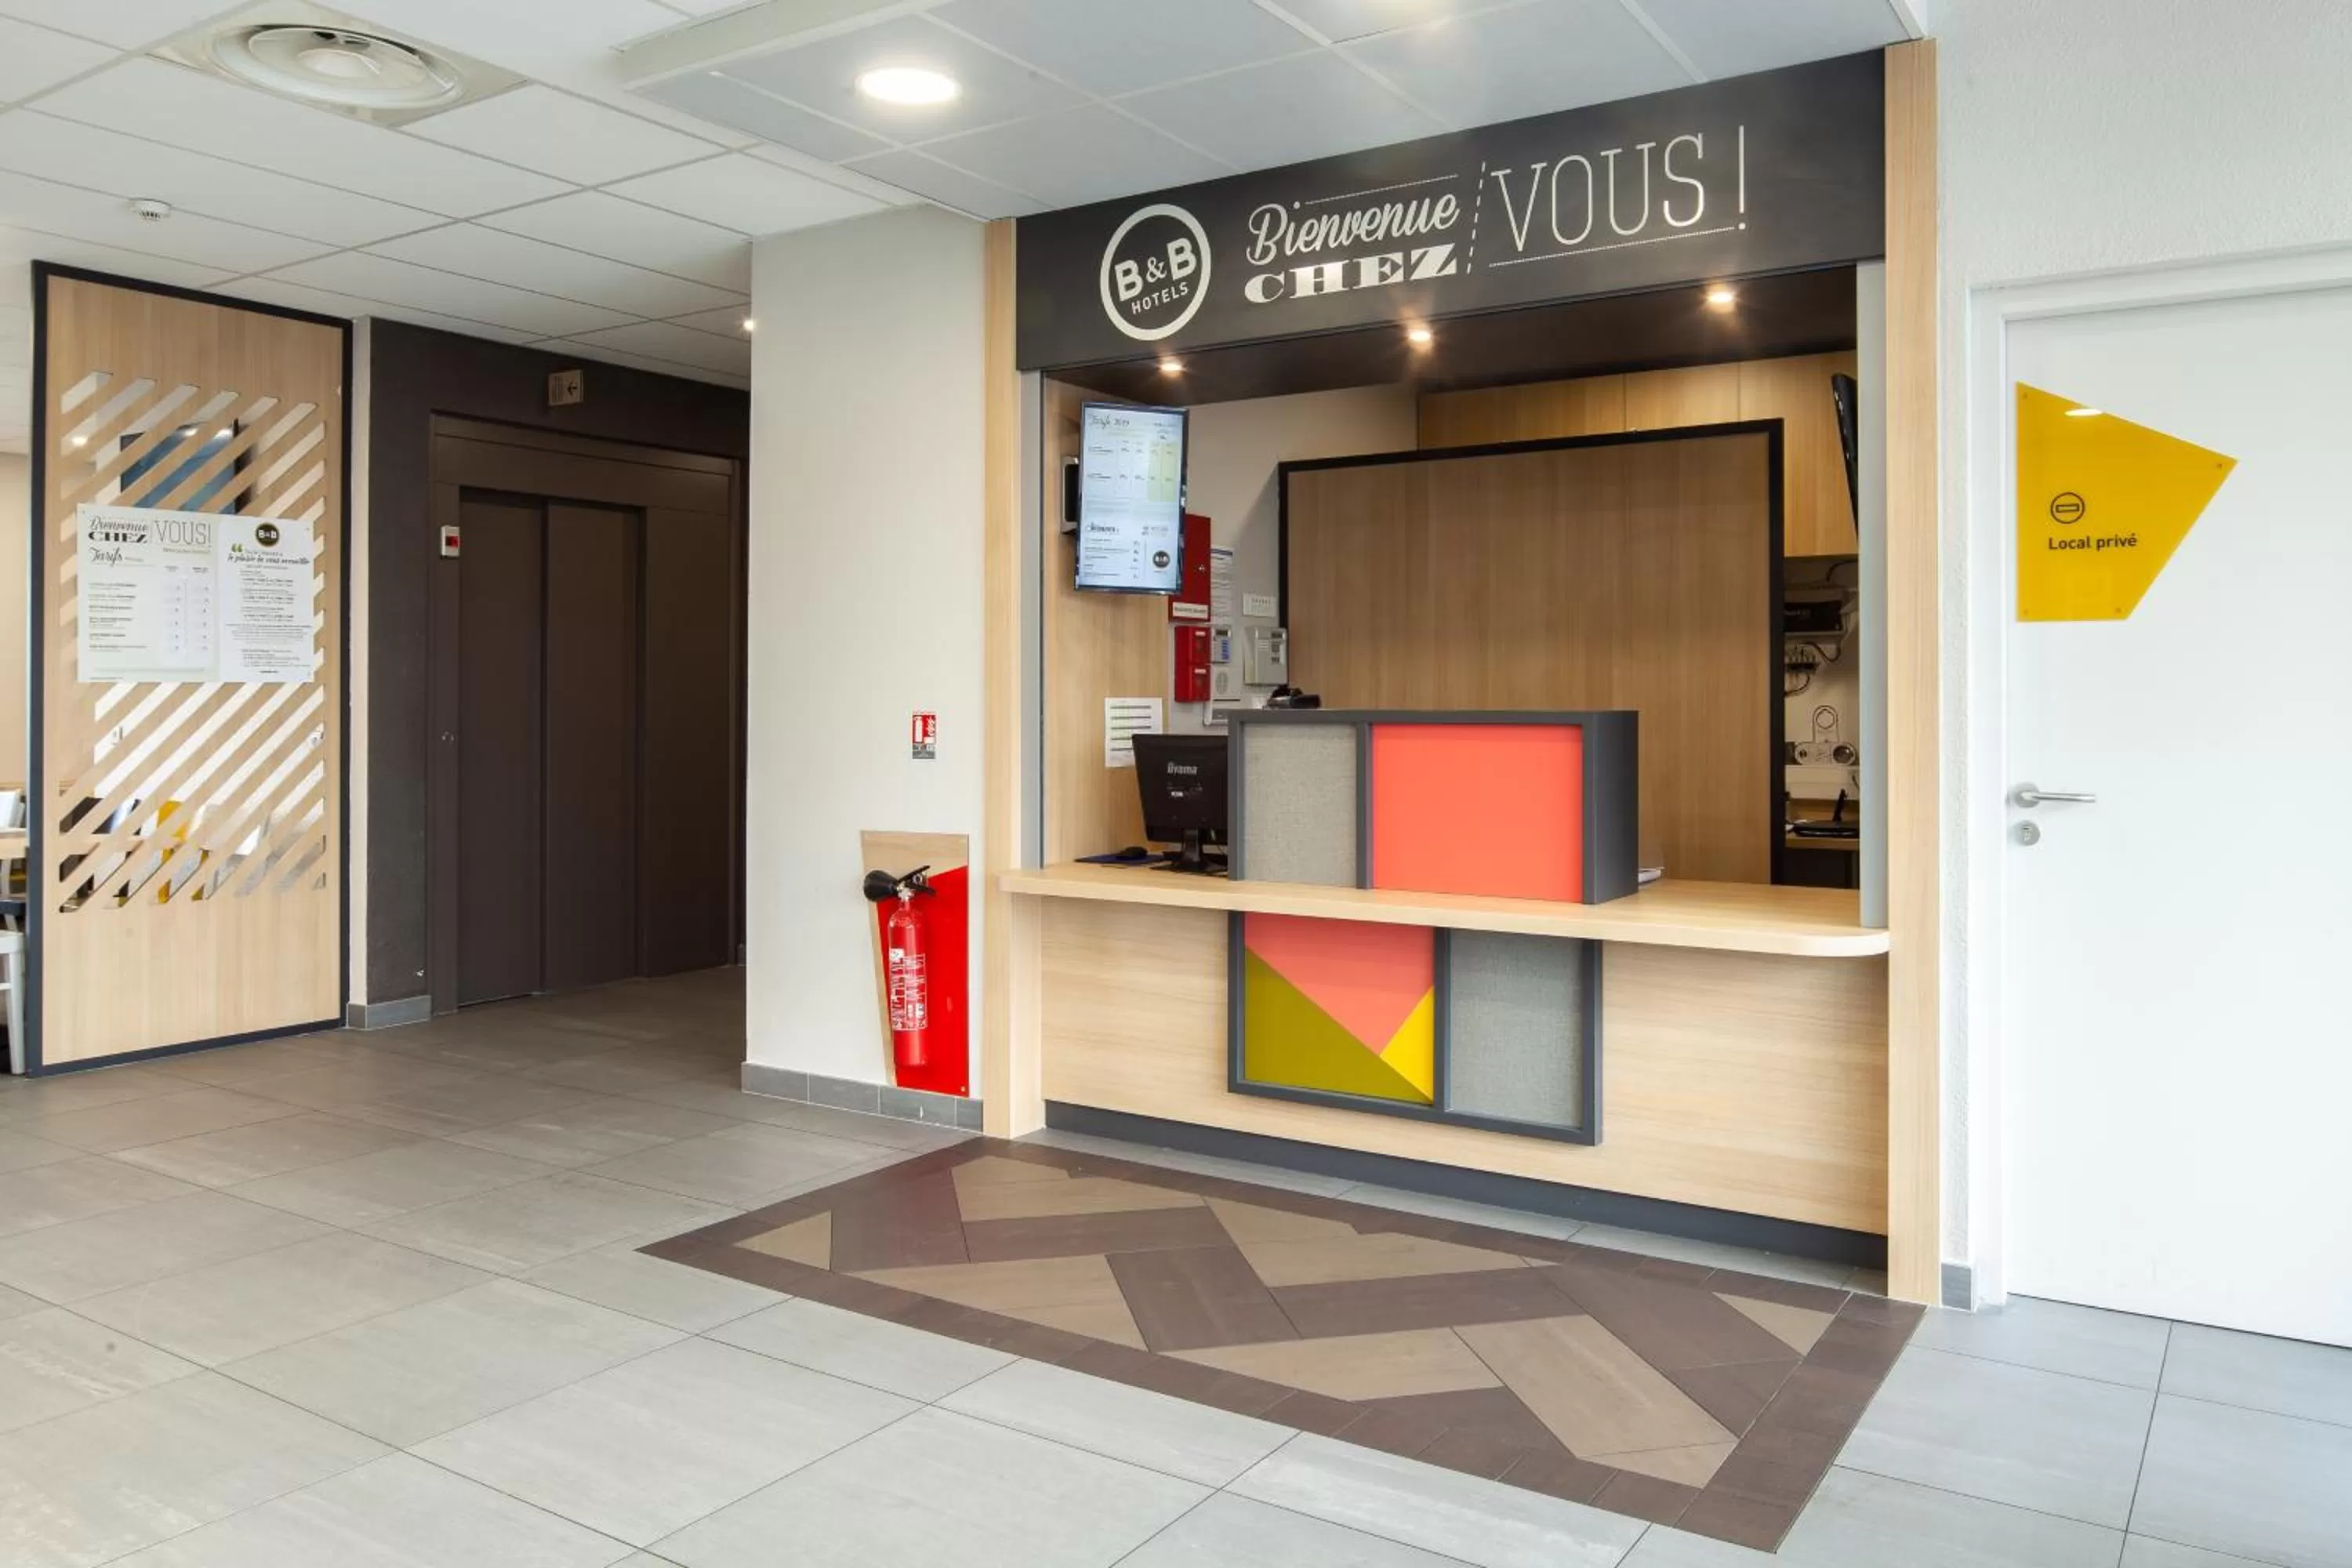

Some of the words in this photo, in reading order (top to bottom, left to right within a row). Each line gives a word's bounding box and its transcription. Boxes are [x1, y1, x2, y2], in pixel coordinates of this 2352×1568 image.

[1246, 194, 1461, 266] Bienvenue
[1114, 238, 1197, 302] B&B
[1244, 242, 1457, 303] CHEZ
[1131, 281, 1189, 314] HOTELS
[88, 531, 148, 543] CHEZ
[2049, 535, 2091, 550] Local
[2096, 533, 2137, 551] privé
